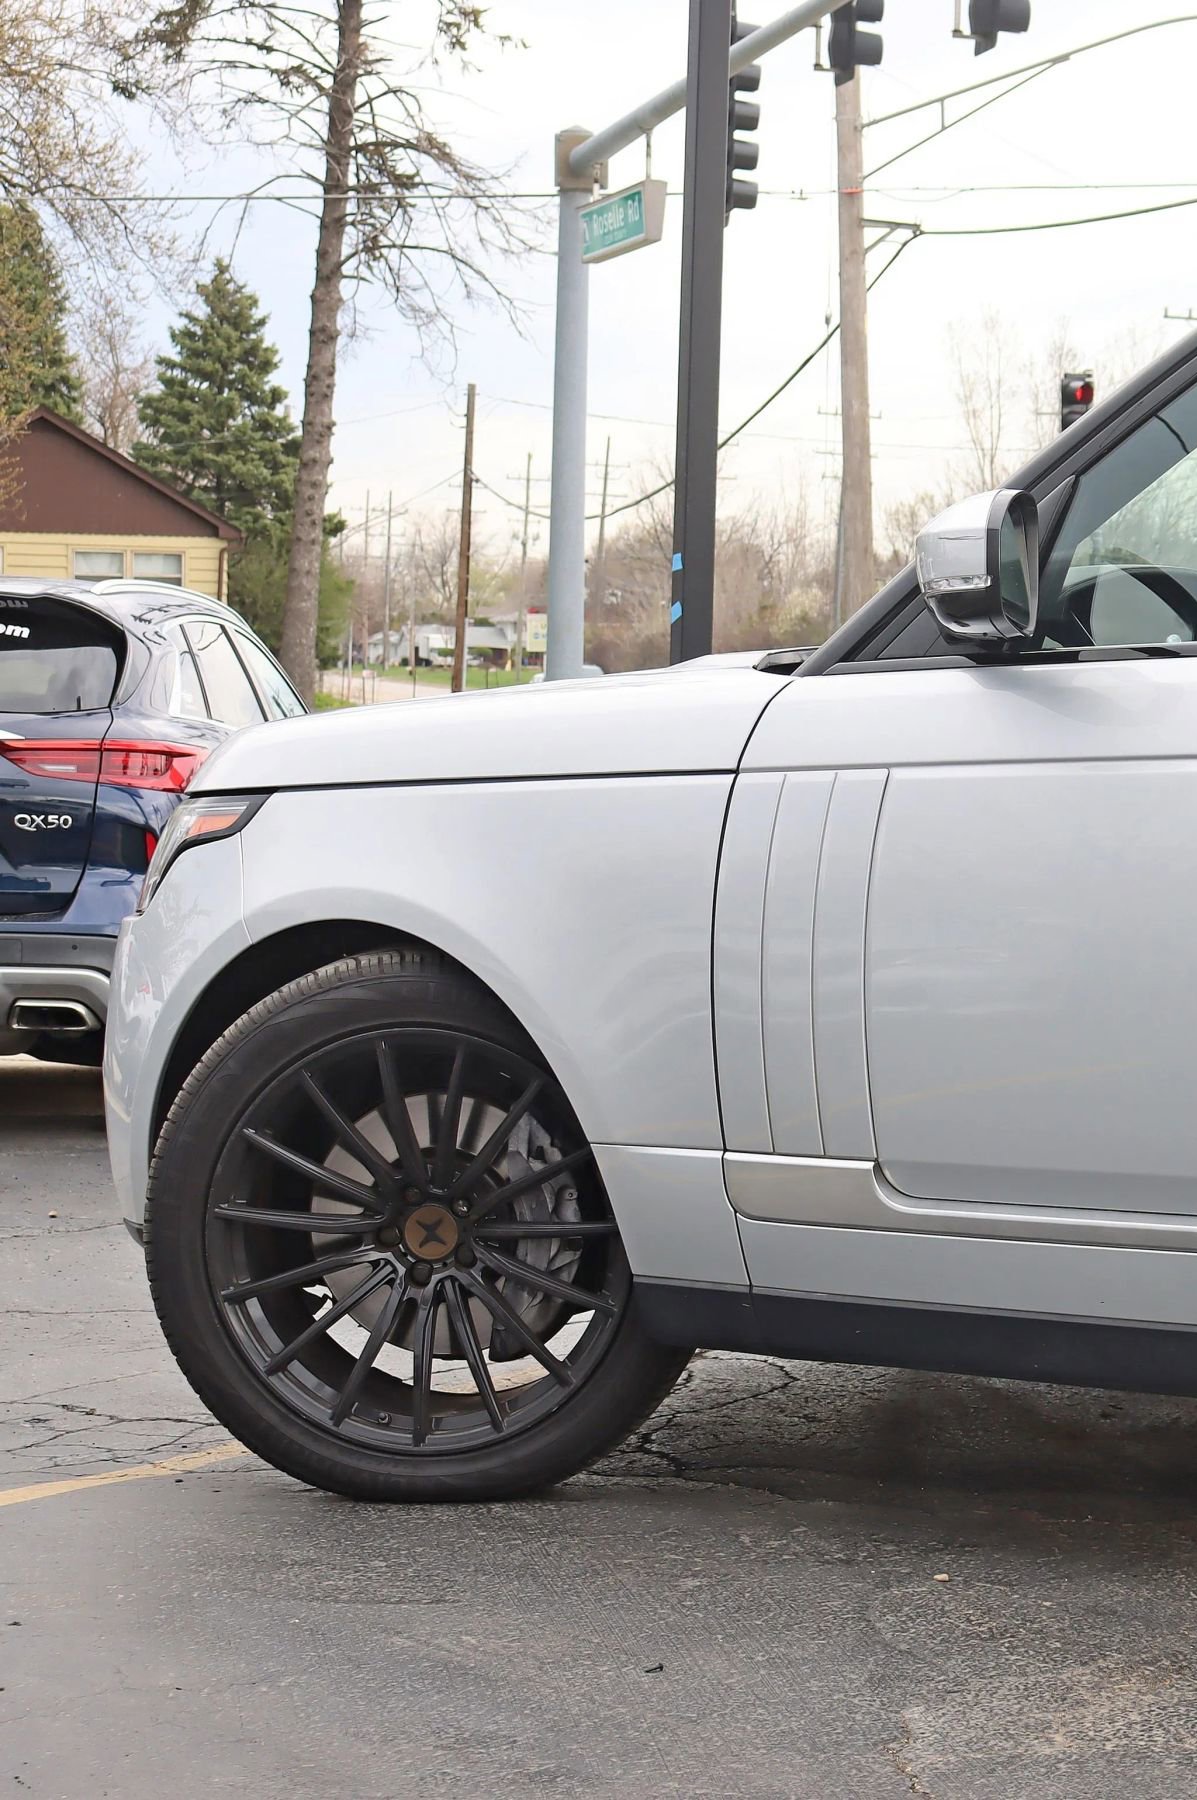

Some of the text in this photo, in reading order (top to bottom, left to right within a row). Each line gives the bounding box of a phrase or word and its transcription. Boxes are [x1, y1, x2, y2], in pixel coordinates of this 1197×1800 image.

[593, 204, 625, 236] Roselle
[627, 194, 640, 223] Rd
[14, 813, 73, 832] QX50
